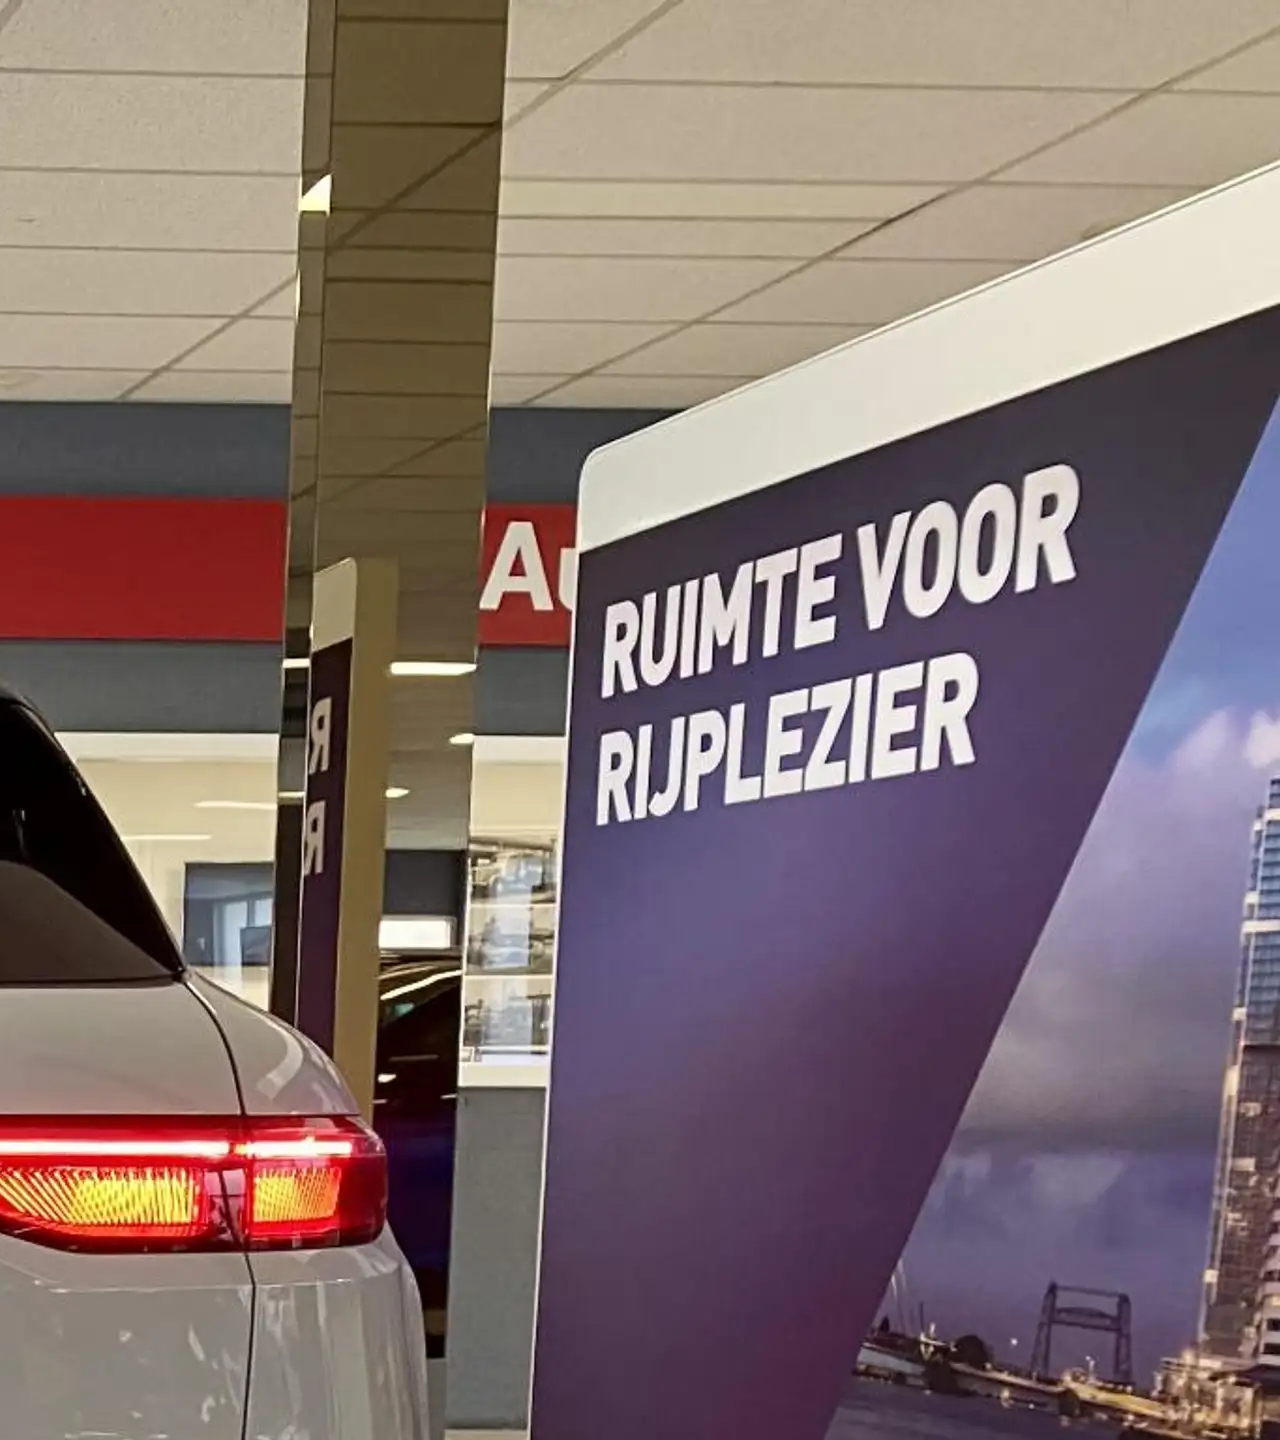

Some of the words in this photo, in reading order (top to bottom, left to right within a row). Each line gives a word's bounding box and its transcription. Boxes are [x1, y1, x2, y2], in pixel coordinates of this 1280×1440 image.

[602, 535, 842, 698] RUIMTE
[859, 464, 1081, 630] VOOR
[596, 653, 979, 826] RIJPLEZIER
